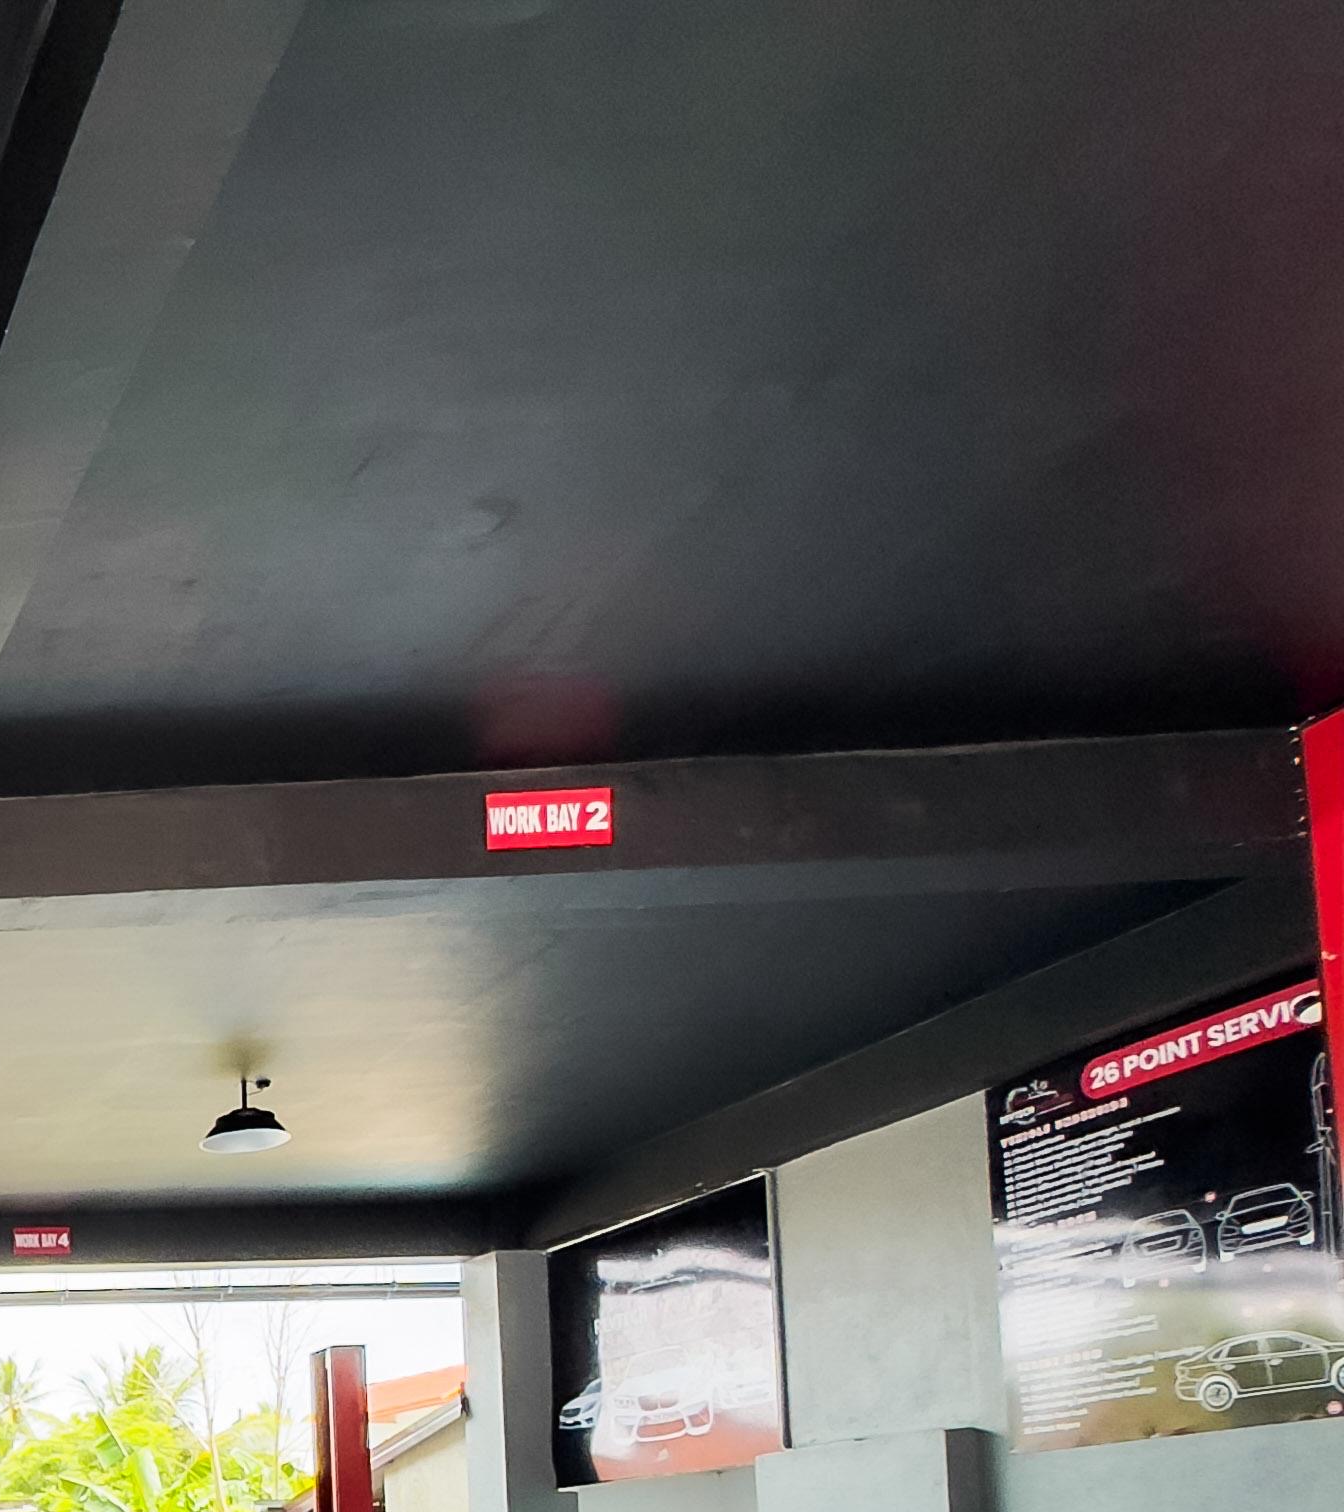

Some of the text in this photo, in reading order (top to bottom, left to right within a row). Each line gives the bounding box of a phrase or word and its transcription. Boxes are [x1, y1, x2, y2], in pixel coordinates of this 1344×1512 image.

[489, 801, 609, 835] WORK BAY 2
[1089, 1061, 1120, 1089] 26
[1122, 1030, 1204, 1077] POINT
[58, 1232, 69, 1248] 4
